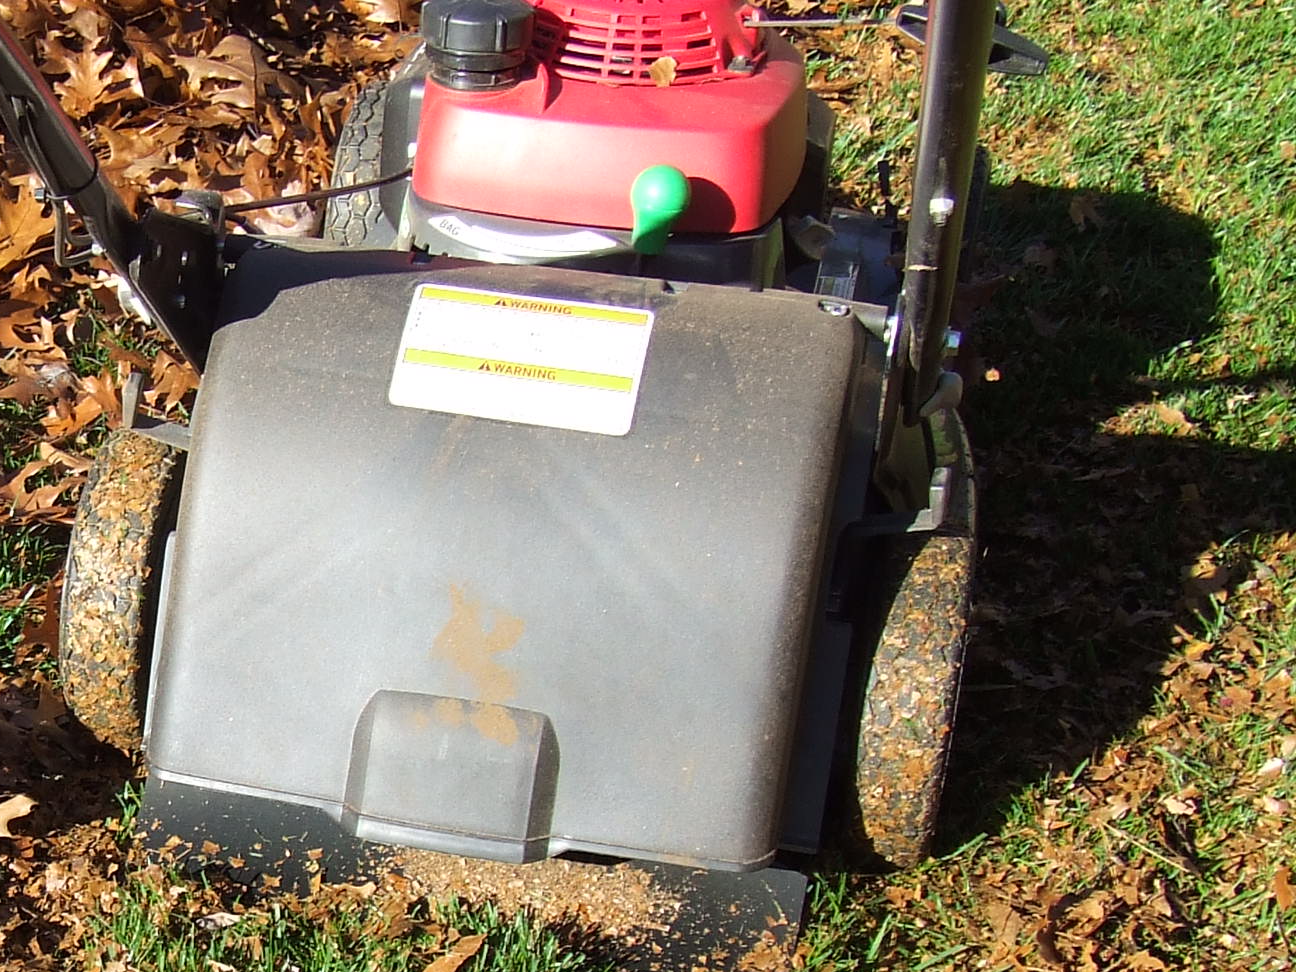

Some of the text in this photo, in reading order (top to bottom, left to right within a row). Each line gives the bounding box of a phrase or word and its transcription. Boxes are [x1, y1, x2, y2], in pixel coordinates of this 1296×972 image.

[439, 219, 460, 236] BAG
[509, 300, 572, 315] WARNING
[494, 363, 556, 381] WARNING
